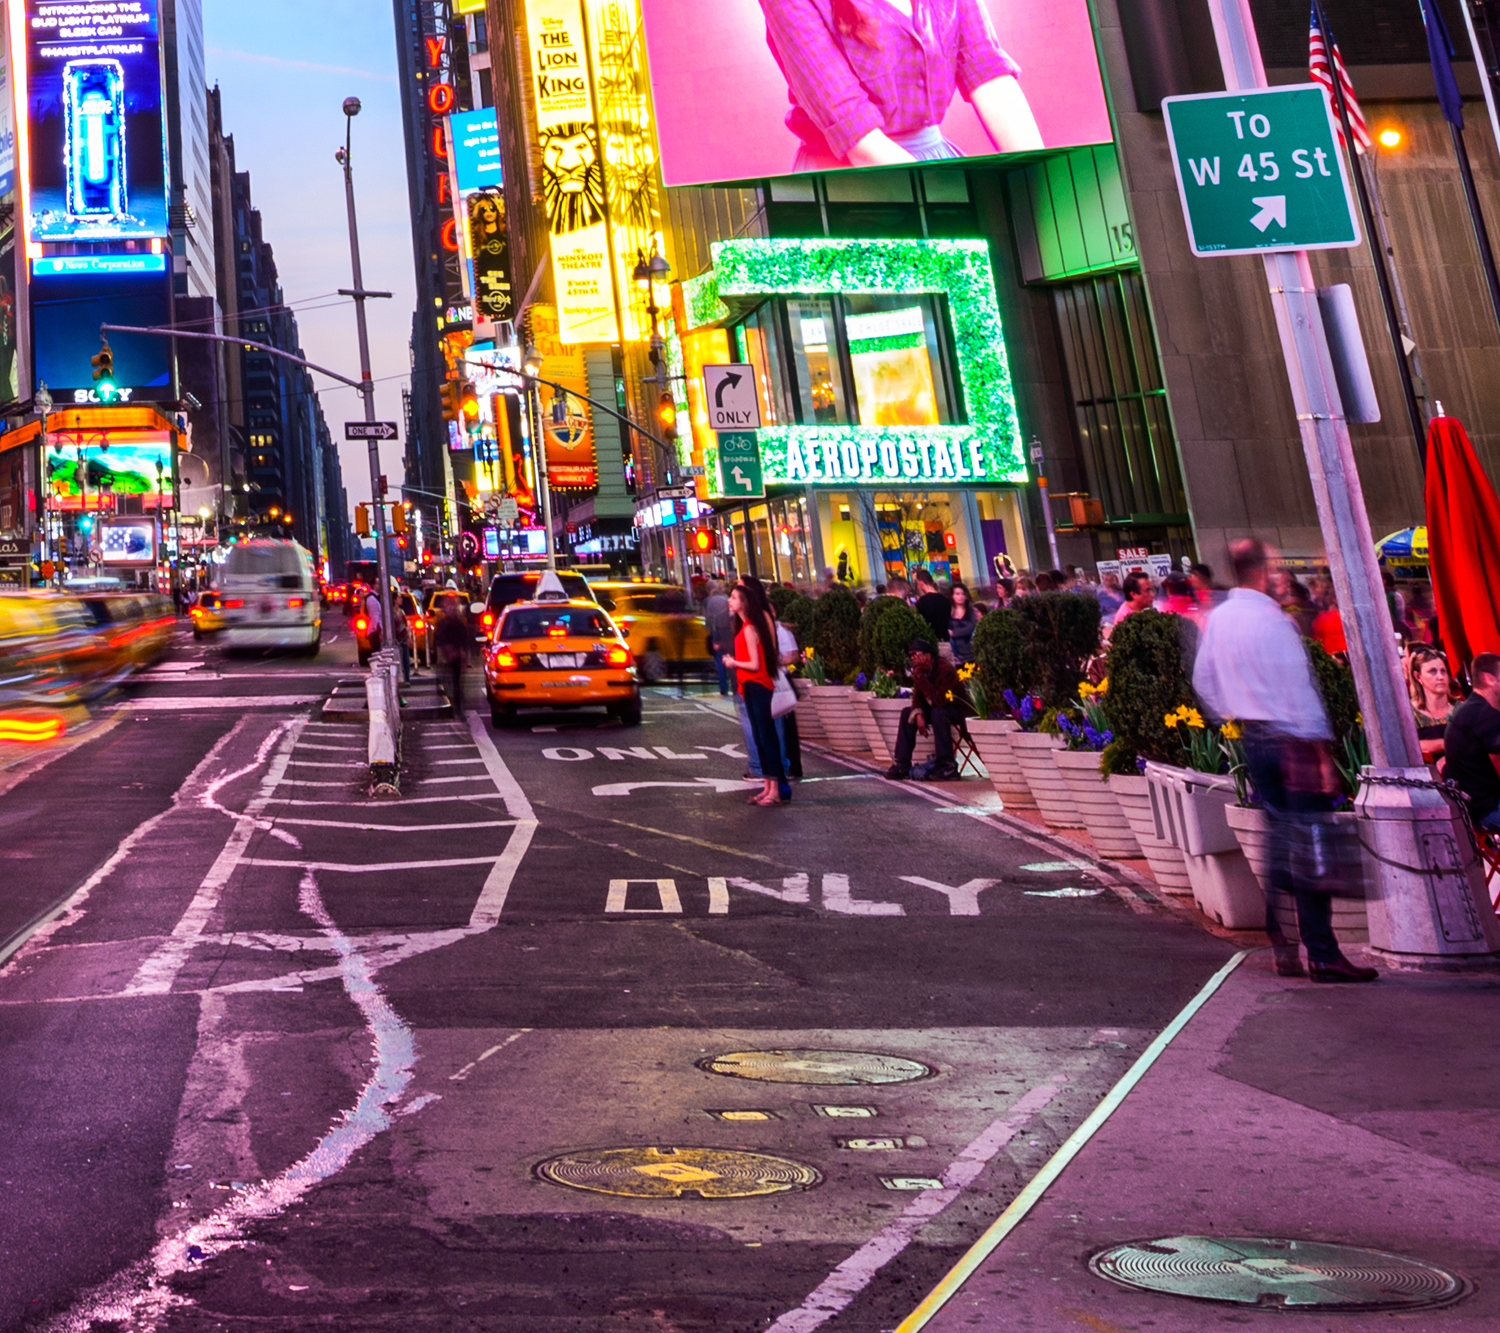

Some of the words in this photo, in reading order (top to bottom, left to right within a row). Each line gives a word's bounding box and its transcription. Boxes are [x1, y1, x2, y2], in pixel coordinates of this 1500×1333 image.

[59, 15, 91, 26] LIGHT
[92, 13, 149, 24] PLATINUM
[540, 32, 569, 45] THE
[538, 50, 578, 71] LION
[538, 75, 585, 98] KING
[1226, 111, 1271, 140] To
[1188, 156, 1220, 187] W
[1237, 152, 1280, 182] 45
[1291, 147, 1331, 178] St
[65, 260, 88, 270] News
[92, 258, 145, 270] Corporation
[561, 259, 602, 269] THEATRE
[543, 338, 577, 357] GUMP
[75, 388, 132, 403] SOY
[716, 411, 751, 423] ONLY
[352, 426, 368, 434] ONE
[373, 426, 390, 435] WAY
[557, 475, 587, 483] MARKET
[1119, 548, 1146, 559] SALE
[541, 743, 748, 762] ONLY
[605, 874, 1002, 917] ONLY
